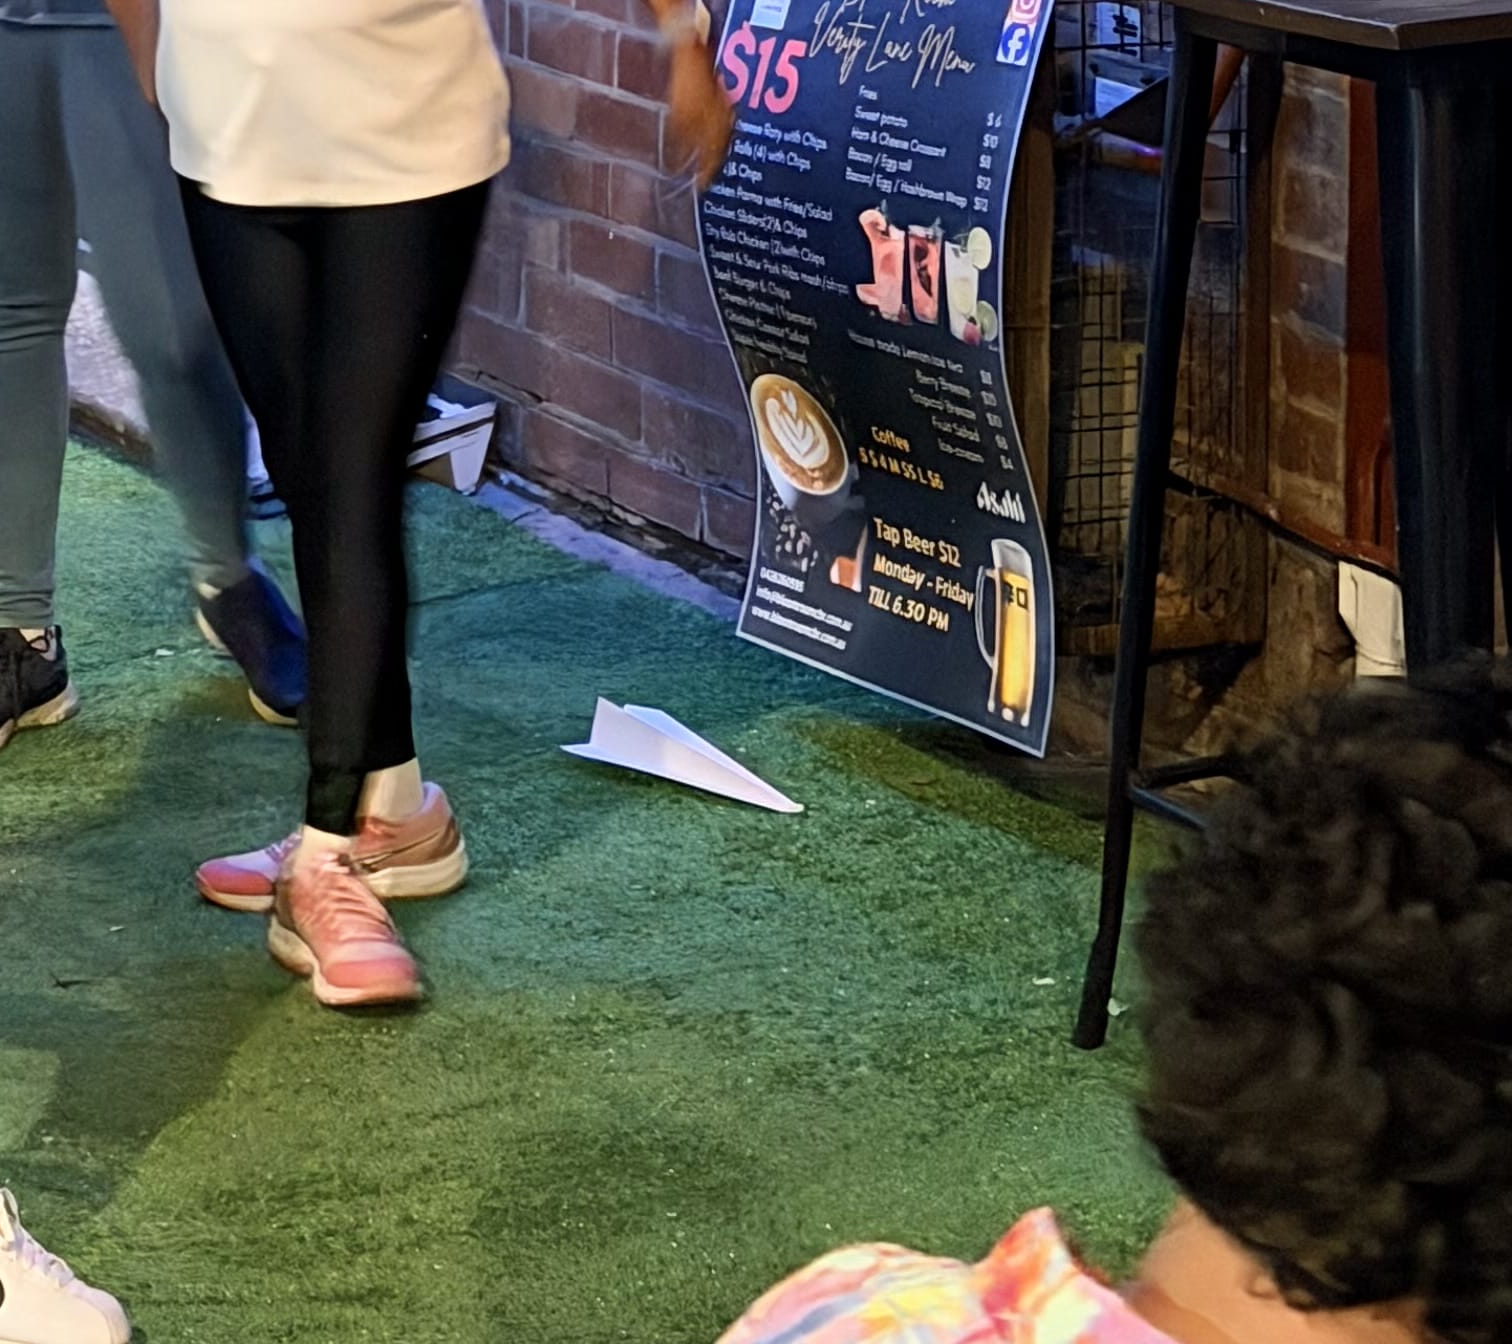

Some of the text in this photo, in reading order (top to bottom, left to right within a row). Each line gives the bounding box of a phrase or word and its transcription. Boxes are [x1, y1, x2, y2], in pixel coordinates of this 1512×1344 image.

[717, 20, 807, 113] $15
[912, 24, 975, 88] Menu
[787, 152, 811, 172] Chips
[802, 132, 827, 152] Chips
[871, 426, 910, 453] Coffee
[977, 481, 1026, 524] Asahi
[873, 516, 962, 568] Tap Beer $12
[873, 553, 926, 591] Monday
[935, 575, 974, 612] Friday
[868, 585, 950, 632] TILL 6.30 PM
